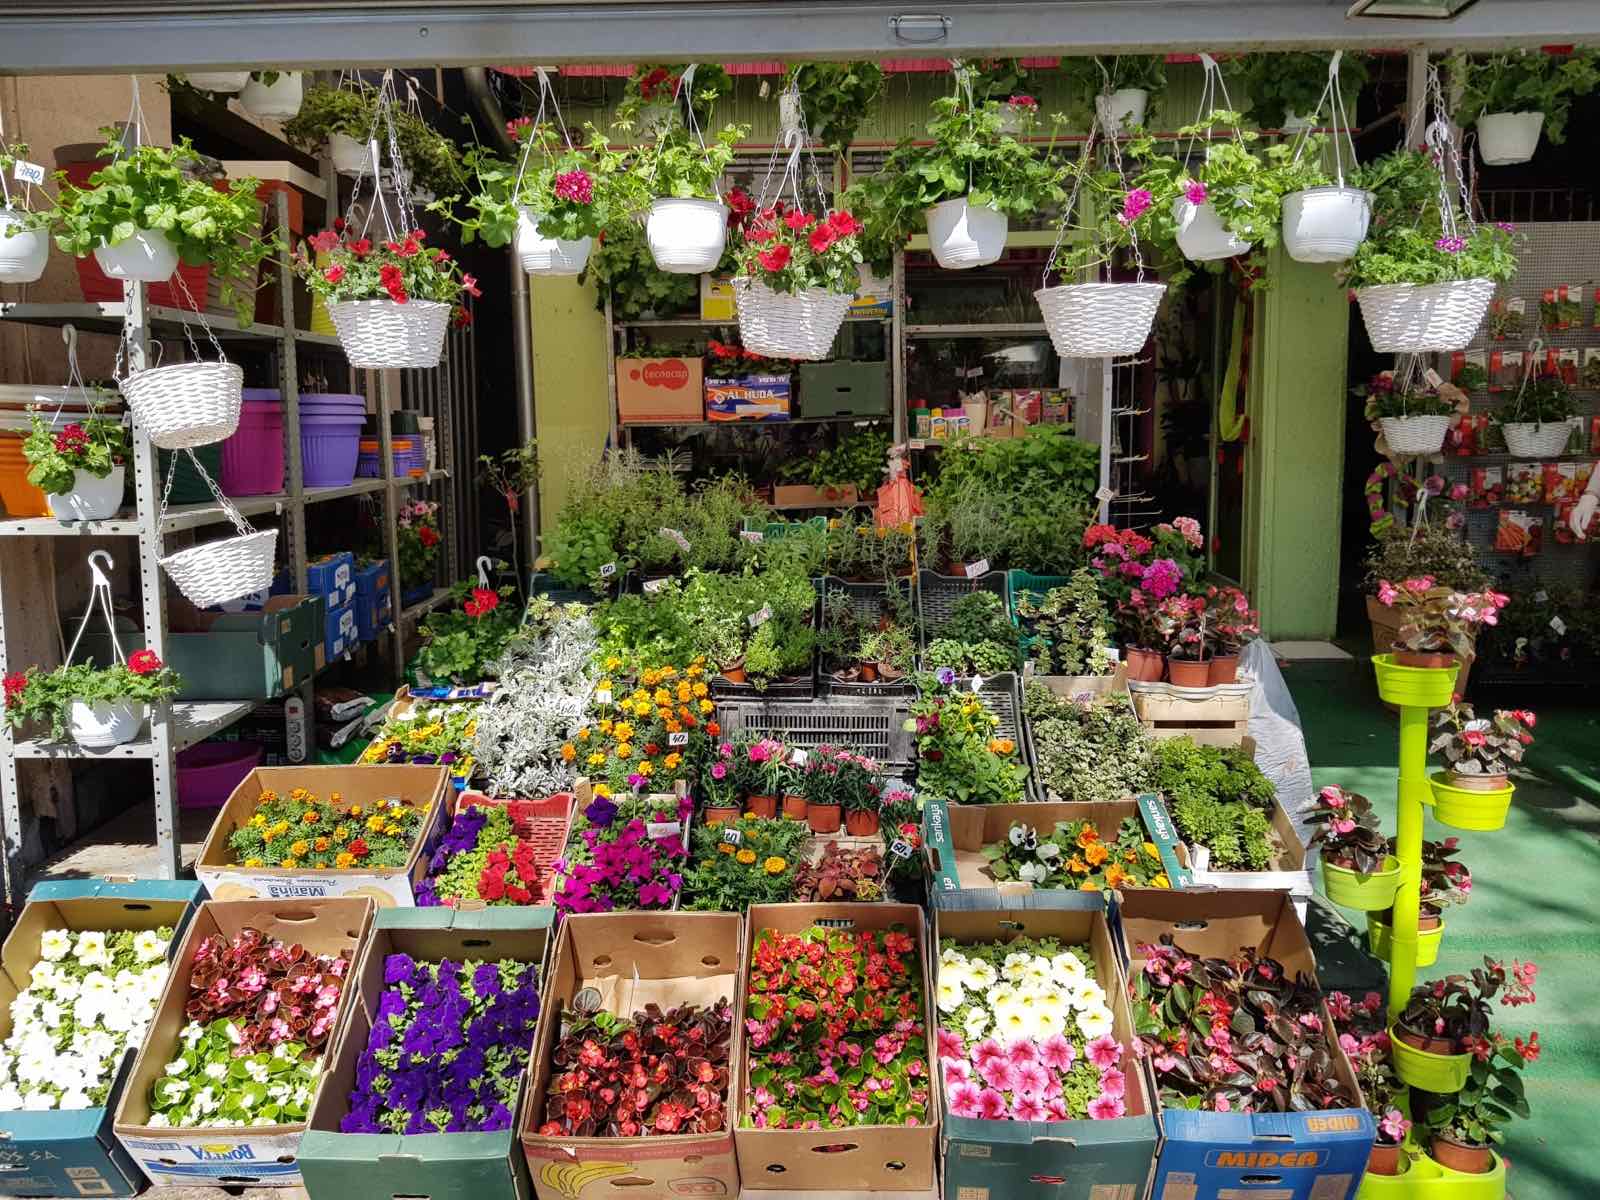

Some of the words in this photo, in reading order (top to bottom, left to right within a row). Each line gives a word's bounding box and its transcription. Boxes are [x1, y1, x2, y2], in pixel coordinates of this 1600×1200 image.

[744, 389, 775, 400] HUDA
[186, 1144, 256, 1160] BONITA
[1216, 1151, 1319, 1168] MIDEA
